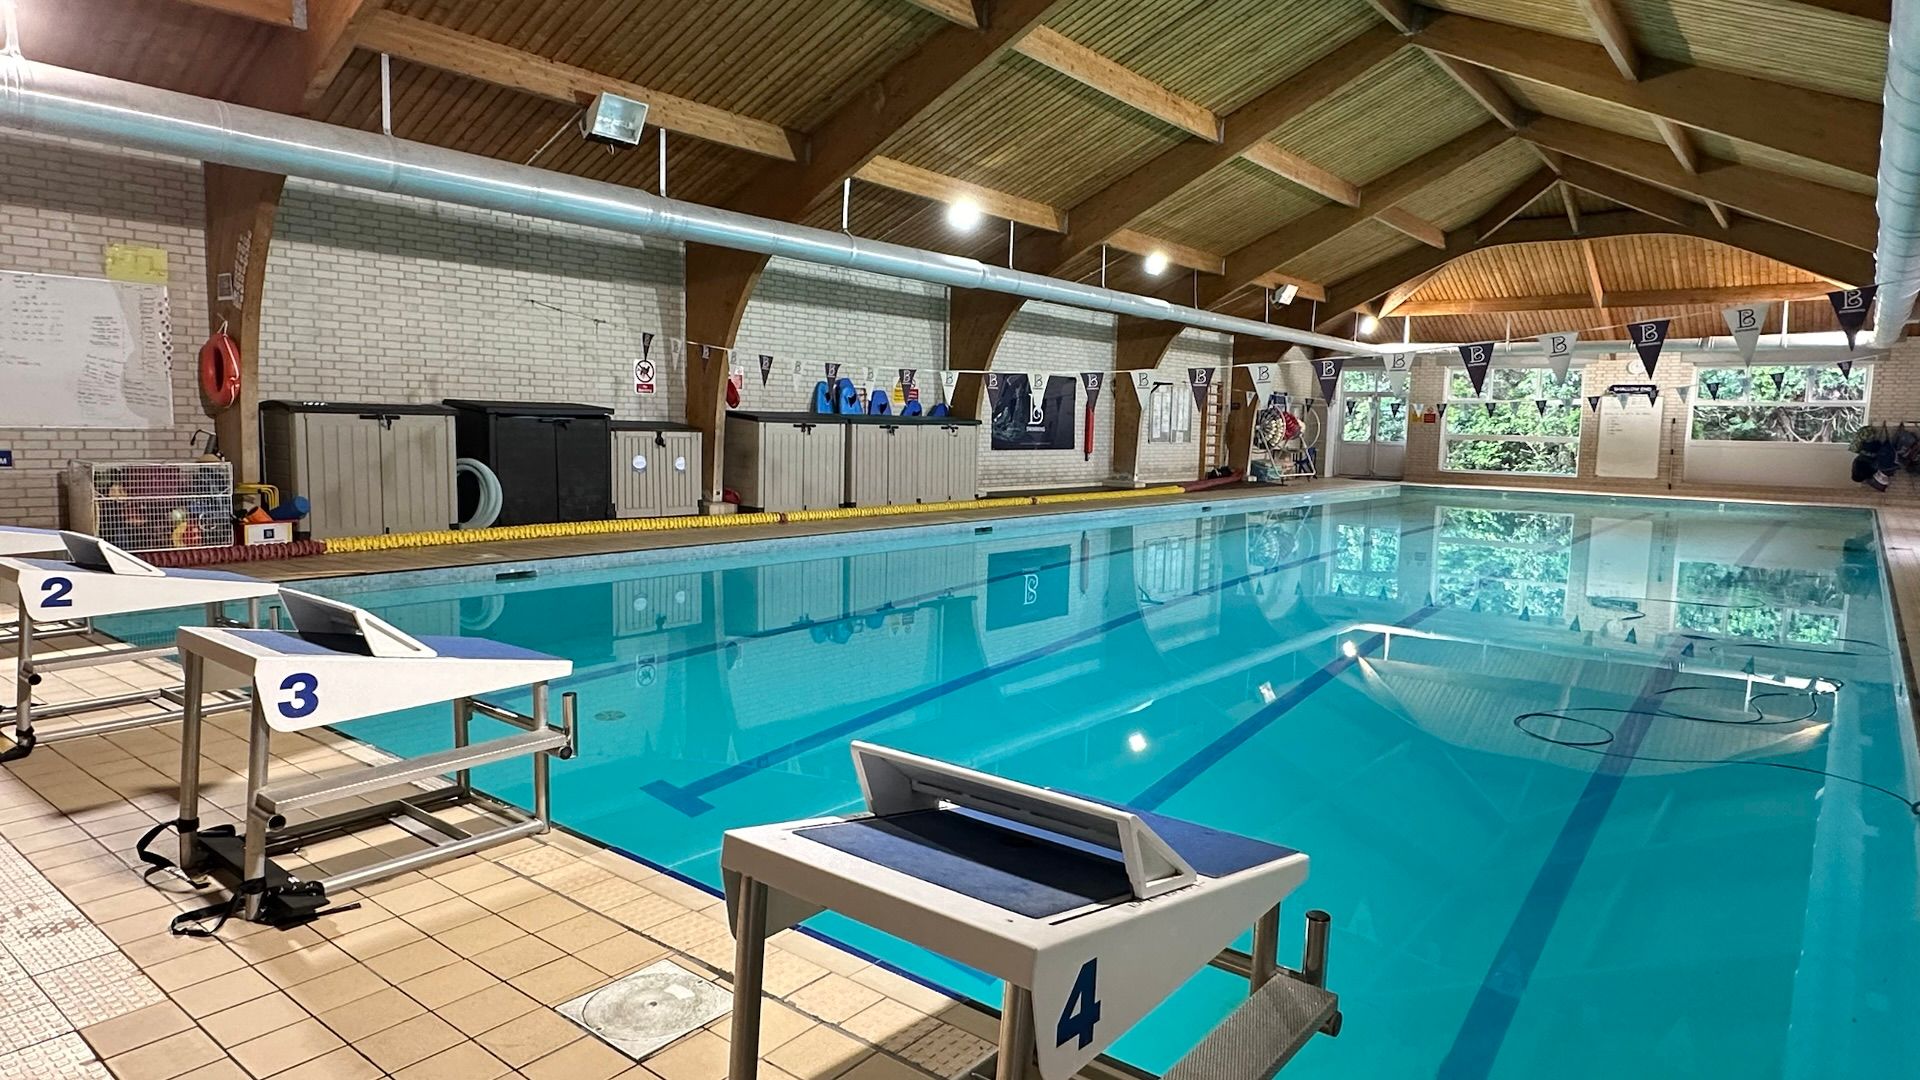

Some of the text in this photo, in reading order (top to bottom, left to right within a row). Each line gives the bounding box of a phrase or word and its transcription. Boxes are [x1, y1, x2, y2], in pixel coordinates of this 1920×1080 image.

[1737, 308, 1756, 328] B
[1640, 324, 1659, 343] B
[1551, 336, 1567, 354] B
[1393, 353, 1405, 368] B
[1469, 346, 1485, 363] B
[1195, 369, 1207, 384] B
[1258, 366, 1270, 381] B
[1321, 360, 1336, 377] B
[1138, 372, 1149, 387] B
[41, 577, 73, 608] 2
[278, 673, 319, 718] 3
[1056, 957, 1101, 1051] 4
